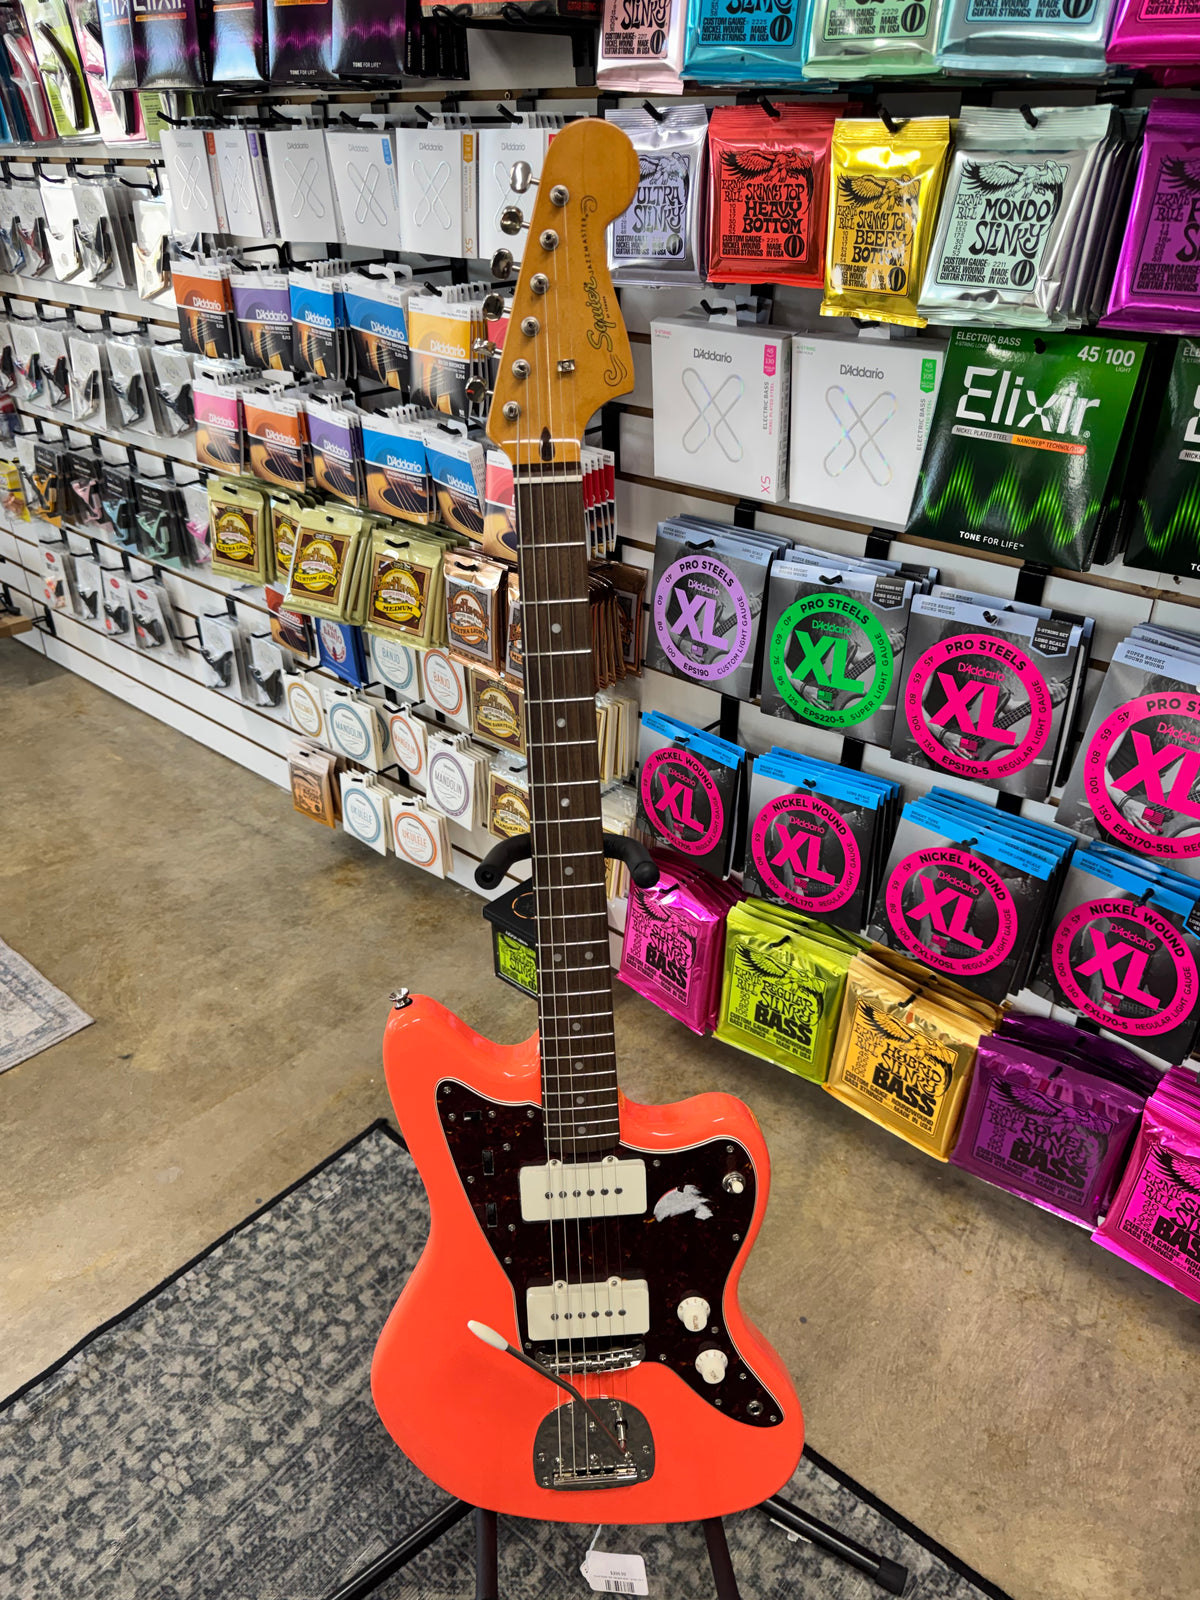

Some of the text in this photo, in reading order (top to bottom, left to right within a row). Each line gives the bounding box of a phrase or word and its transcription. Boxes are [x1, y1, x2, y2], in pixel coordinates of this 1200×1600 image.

[703, 18, 726, 26] CUSTOM
[881, 16, 899, 24] MADE
[971, 9, 1031, 17] GUITAR STRINGS
[1045, 9, 1061, 18] USA
[702, 34, 746, 42] GUITAR STRINGS
[703, 26, 744, 34] NICKEL WOUND
[750, 26, 768, 34] MADE
[722, 177, 745, 190] ERNIE
[746, 184, 805, 201] SKINNY TOP
[637, 186, 682, 206] ULTRA
[724, 190, 744, 202] BALL
[956, 191, 984, 206] ERNIE
[1154, 190, 1190, 208] ERNIE
[632, 204, 687, 234] SLINKY
[744, 201, 802, 218] HEAVY
[956, 206, 977, 220] BALL
[981, 198, 1051, 222] MONDO
[1154, 206, 1184, 222] BALL
[742, 218, 803, 234] BOTTOM
[838, 216, 854, 230] BALL
[857, 210, 907, 231] SKINNY TOP
[465, 238, 473, 254] XS
[581, 218, 595, 276] JAZZMASTER
[854, 230, 908, 248] BEEFY
[968, 220, 1048, 259] SLINKY
[942, 265, 985, 274] NICKEL WOUND
[944, 256, 988, 267] CUSTOM GAUGE
[991, 268, 1009, 276] MADE
[940, 273, 985, 283] GUITAR STRINGS
[996, 277, 1009, 285] USA
[192, 296, 221, 310] D'Addario
[587, 274, 616, 352] Squier
[255, 308, 288, 322] D'Addario
[305, 310, 332, 327] D'Addario
[371, 320, 404, 340] D'Addario
[956, 331, 1021, 347] ELECTRIC BASS
[431, 340, 466, 358] D'Addario
[693, 348, 732, 363] D'Addario
[1077, 345, 1136, 367] 45 100
[840, 364, 884, 380] D'Addario
[956, 366, 1100, 436] Elixir
[265, 428, 297, 446] D'Addario
[956, 427, 973, 436] NICKEL
[973, 430, 992, 438] PLATED
[323, 440, 349, 459] D'Addario
[387, 455, 422, 472] D'Addario
[447, 474, 474, 494] D'Addario
[761, 475, 770, 494] XS
[959, 530, 999, 547] TONE FOR
[679, 560, 734, 588] PRO STEELS
[688, 579, 720, 597] D'Addario
[670, 587, 729, 650] XL
[800, 599, 870, 625] PRO STEELS
[717, 596, 748, 675] CUSTOM LIGHT GAUGE
[812, 620, 853, 636] D'Addario
[791, 630, 865, 694] XL
[945, 640, 1027, 672] PRO STEELS
[683, 662, 709, 677] EPS190
[850, 632, 889, 721] SUPER LIGHT GAUGE
[958, 662, 1006, 682] D'Addario
[433, 674, 450, 689] BANJO
[803, 706, 845, 724] EPS220-5
[928, 671, 1017, 746] XL
[1146, 698, 1181, 712] PRO
[335, 721, 363, 739] MANDOLIN
[998, 680, 1047, 773] REGULAR LIGHT GAUGE
[655, 751, 713, 790] NICKEL WOUND
[941, 756, 989, 775] EPS170-5
[1110, 730, 1200, 820] XL
[434, 772, 462, 794] MANDOLIN
[655, 772, 705, 834] XL
[1090, 776, 1112, 822] 100 130
[772, 798, 847, 836] NICKEL WOUND
[789, 815, 825, 834] D'Addario
[402, 829, 427, 847] UKULELE
[1113, 824, 1178, 854] EPS170-5SL
[770, 822, 836, 887] XL
[819, 843, 856, 907] REGULAR LIGHT GAUGE
[919, 852, 1006, 901] NICKEL WOUND
[937, 870, 980, 896] D'Addario
[784, 891, 814, 908] EXL170
[905, 874, 984, 950] XL
[651, 924, 687, 950] SUPER
[962, 908, 1012, 971] REGULAR LIGHT GAUGE
[1089, 903, 1185, 958] NICKEL WOUND
[1109, 922, 1156, 951] D'Addario
[646, 942, 688, 989] BASS
[912, 943, 956, 970] EXL170SL
[735, 966, 762, 985] ERNIE
[1074, 926, 1160, 1010] XL
[736, 977, 758, 996] BALL
[762, 980, 816, 1014] REGULAR
[758, 990, 816, 1026] SLINKY
[1135, 967, 1192, 1031] REGULAR LIGHT GAUGE
[754, 1004, 813, 1046] BASS
[1083, 1002, 1128, 1029] EXL170-5
[855, 1023, 883, 1047] ERNIE
[856, 1036, 878, 1058] BALL
[885, 1042, 942, 1083] HYBRID
[877, 1053, 940, 1097] SLINKY
[872, 1064, 937, 1117] BASS
[988, 1100, 1025, 1122] ERNIE
[990, 1112, 1017, 1133] BALL
[1024, 1116, 1091, 1156] POWER
[1017, 1128, 1090, 1168] SLINKY
[1010, 1140, 1088, 1189] BASS
[1143, 1168, 1185, 1200] ERNIE
[1142, 1184, 1173, 1212] BALL
[1122, 1225, 1174, 1262] BASS STRINGS
[1125, 1220, 1181, 1258] CUSTOM GAUGE
